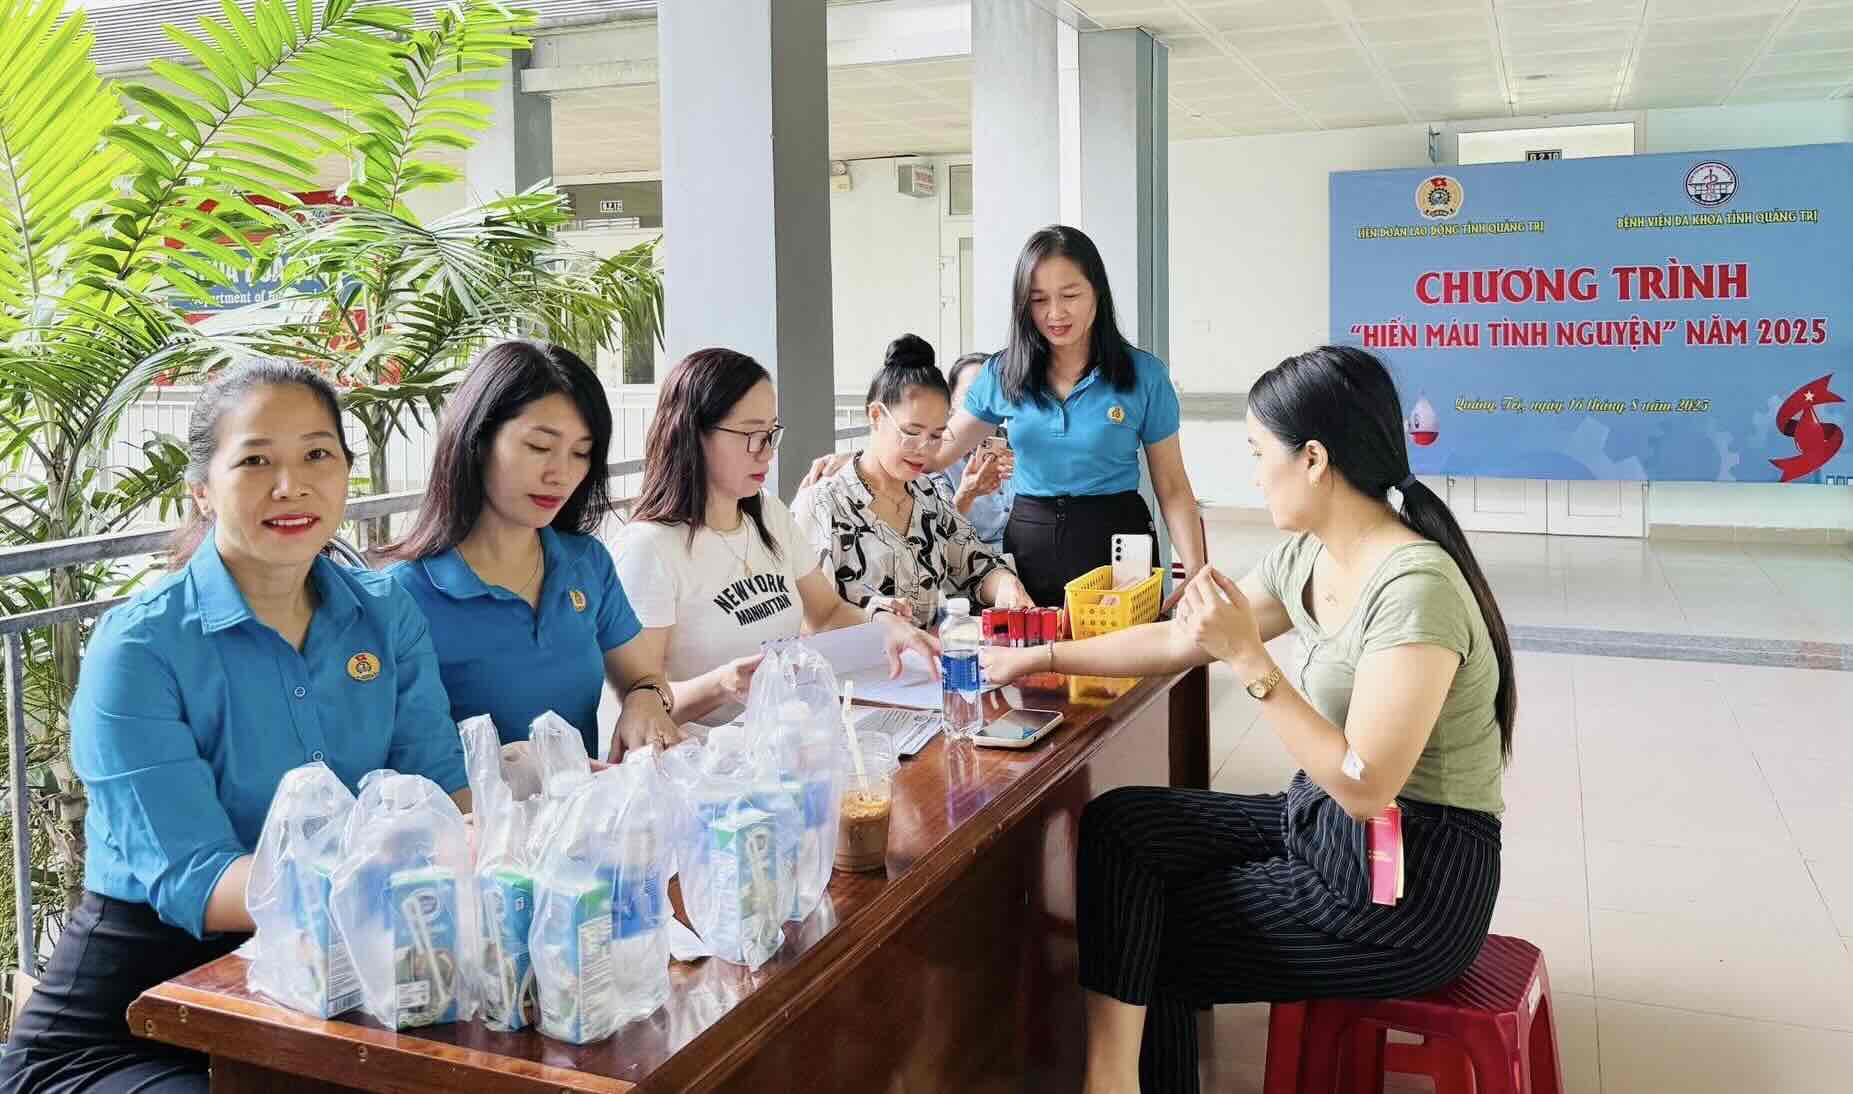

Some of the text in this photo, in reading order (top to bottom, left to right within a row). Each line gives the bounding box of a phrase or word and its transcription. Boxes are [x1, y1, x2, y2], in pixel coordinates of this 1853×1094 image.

[1692, 213, 1724, 225] KHOA
[1727, 210, 1753, 225] TỈNH
[1755, 208, 1796, 224] QUẢNG
[1800, 210, 1818, 224] TRỊ
[1415, 257, 1750, 305] CHƯƠNG TRÌNH
[1425, 318, 1480, 348] MÁU
[1487, 317, 1549, 348] TÌNH
[1685, 313, 1748, 346] NĂM
[1757, 318, 1827, 346] 2025
[735, 593, 792, 626] MANHATTAN
